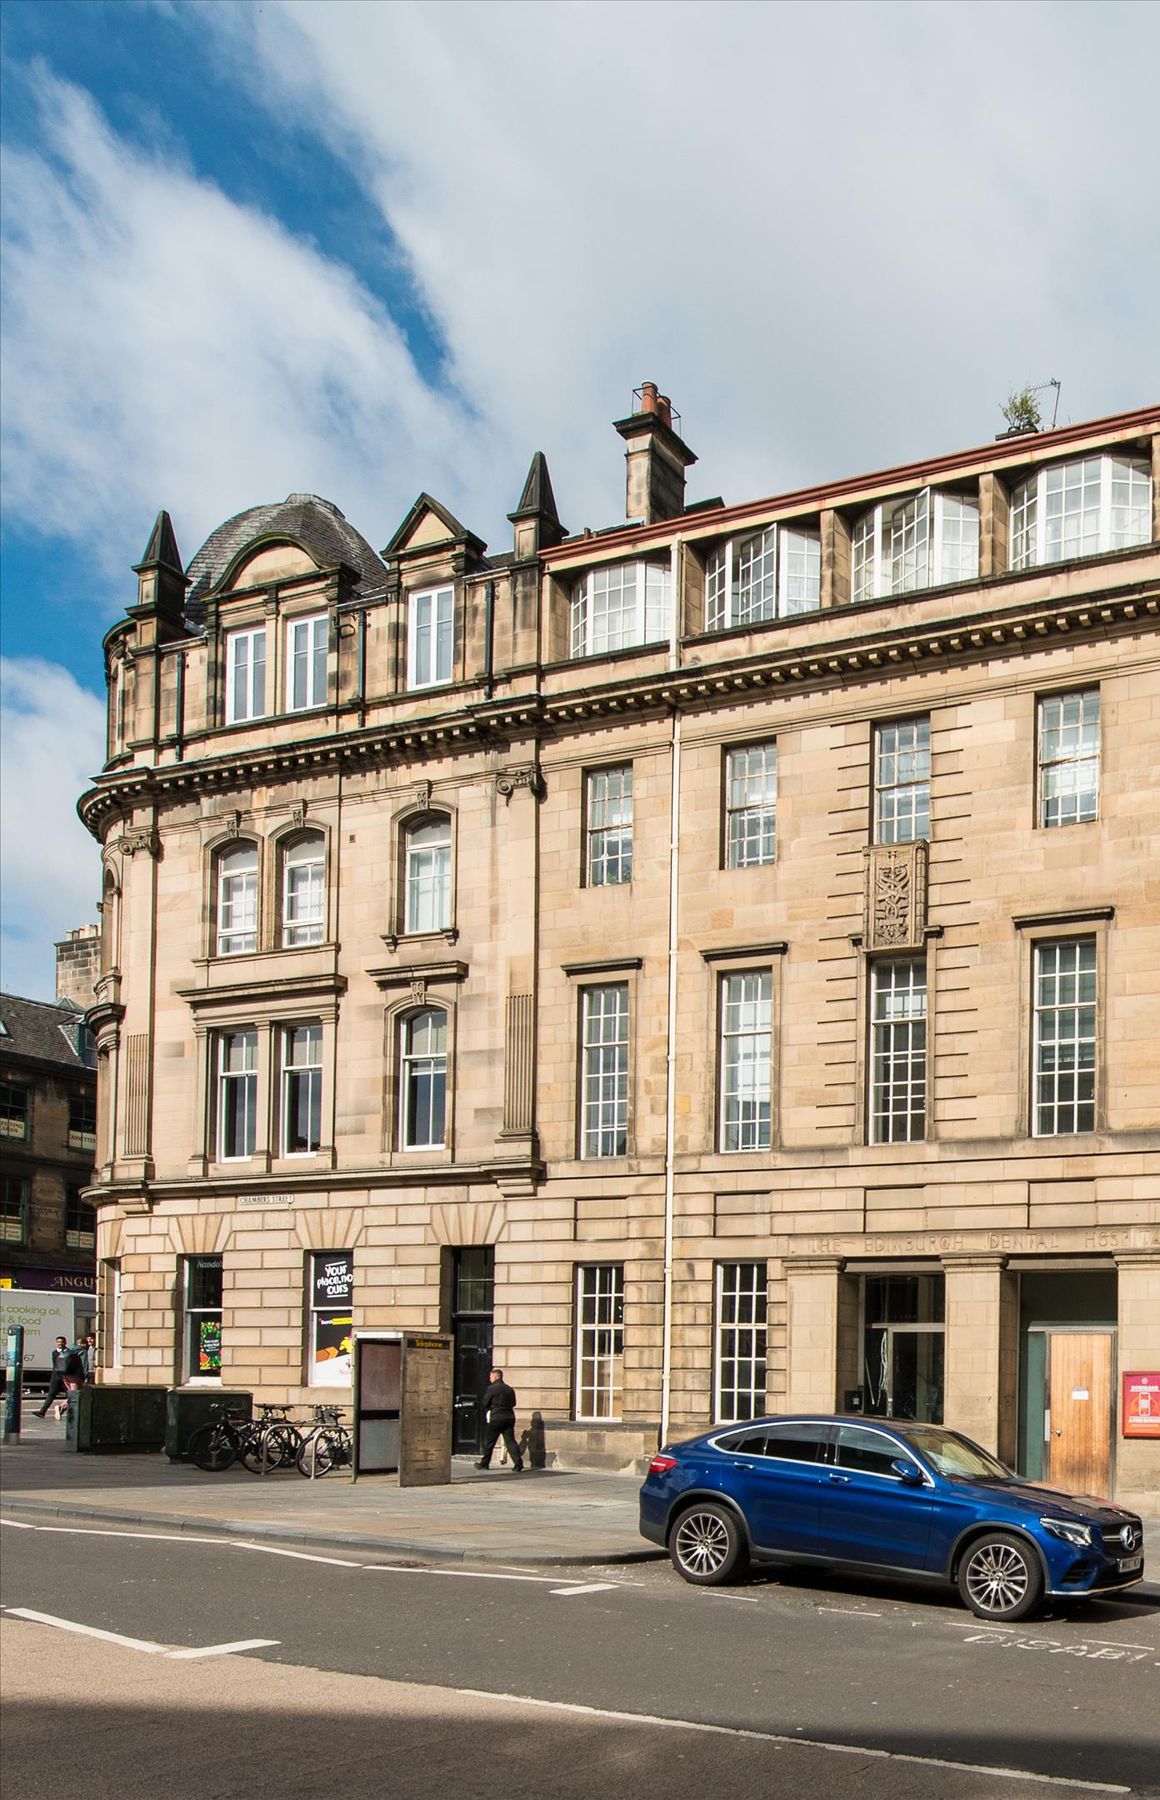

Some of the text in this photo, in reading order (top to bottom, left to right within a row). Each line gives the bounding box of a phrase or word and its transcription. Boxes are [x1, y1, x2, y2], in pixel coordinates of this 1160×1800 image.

[240, 1195, 293, 1204] CHAMBERS STREET
[809, 1238, 841, 1253] THE
[863, 1233, 964, 1252] EDINBURGH
[987, 1232, 1059, 1250] DENTAL
[50, 1276, 96, 1290] ANGU
[7, 1305, 47, 1315] cooking
[18, 1316, 41, 1325] food
[415, 1339, 443, 1348] Telephone
